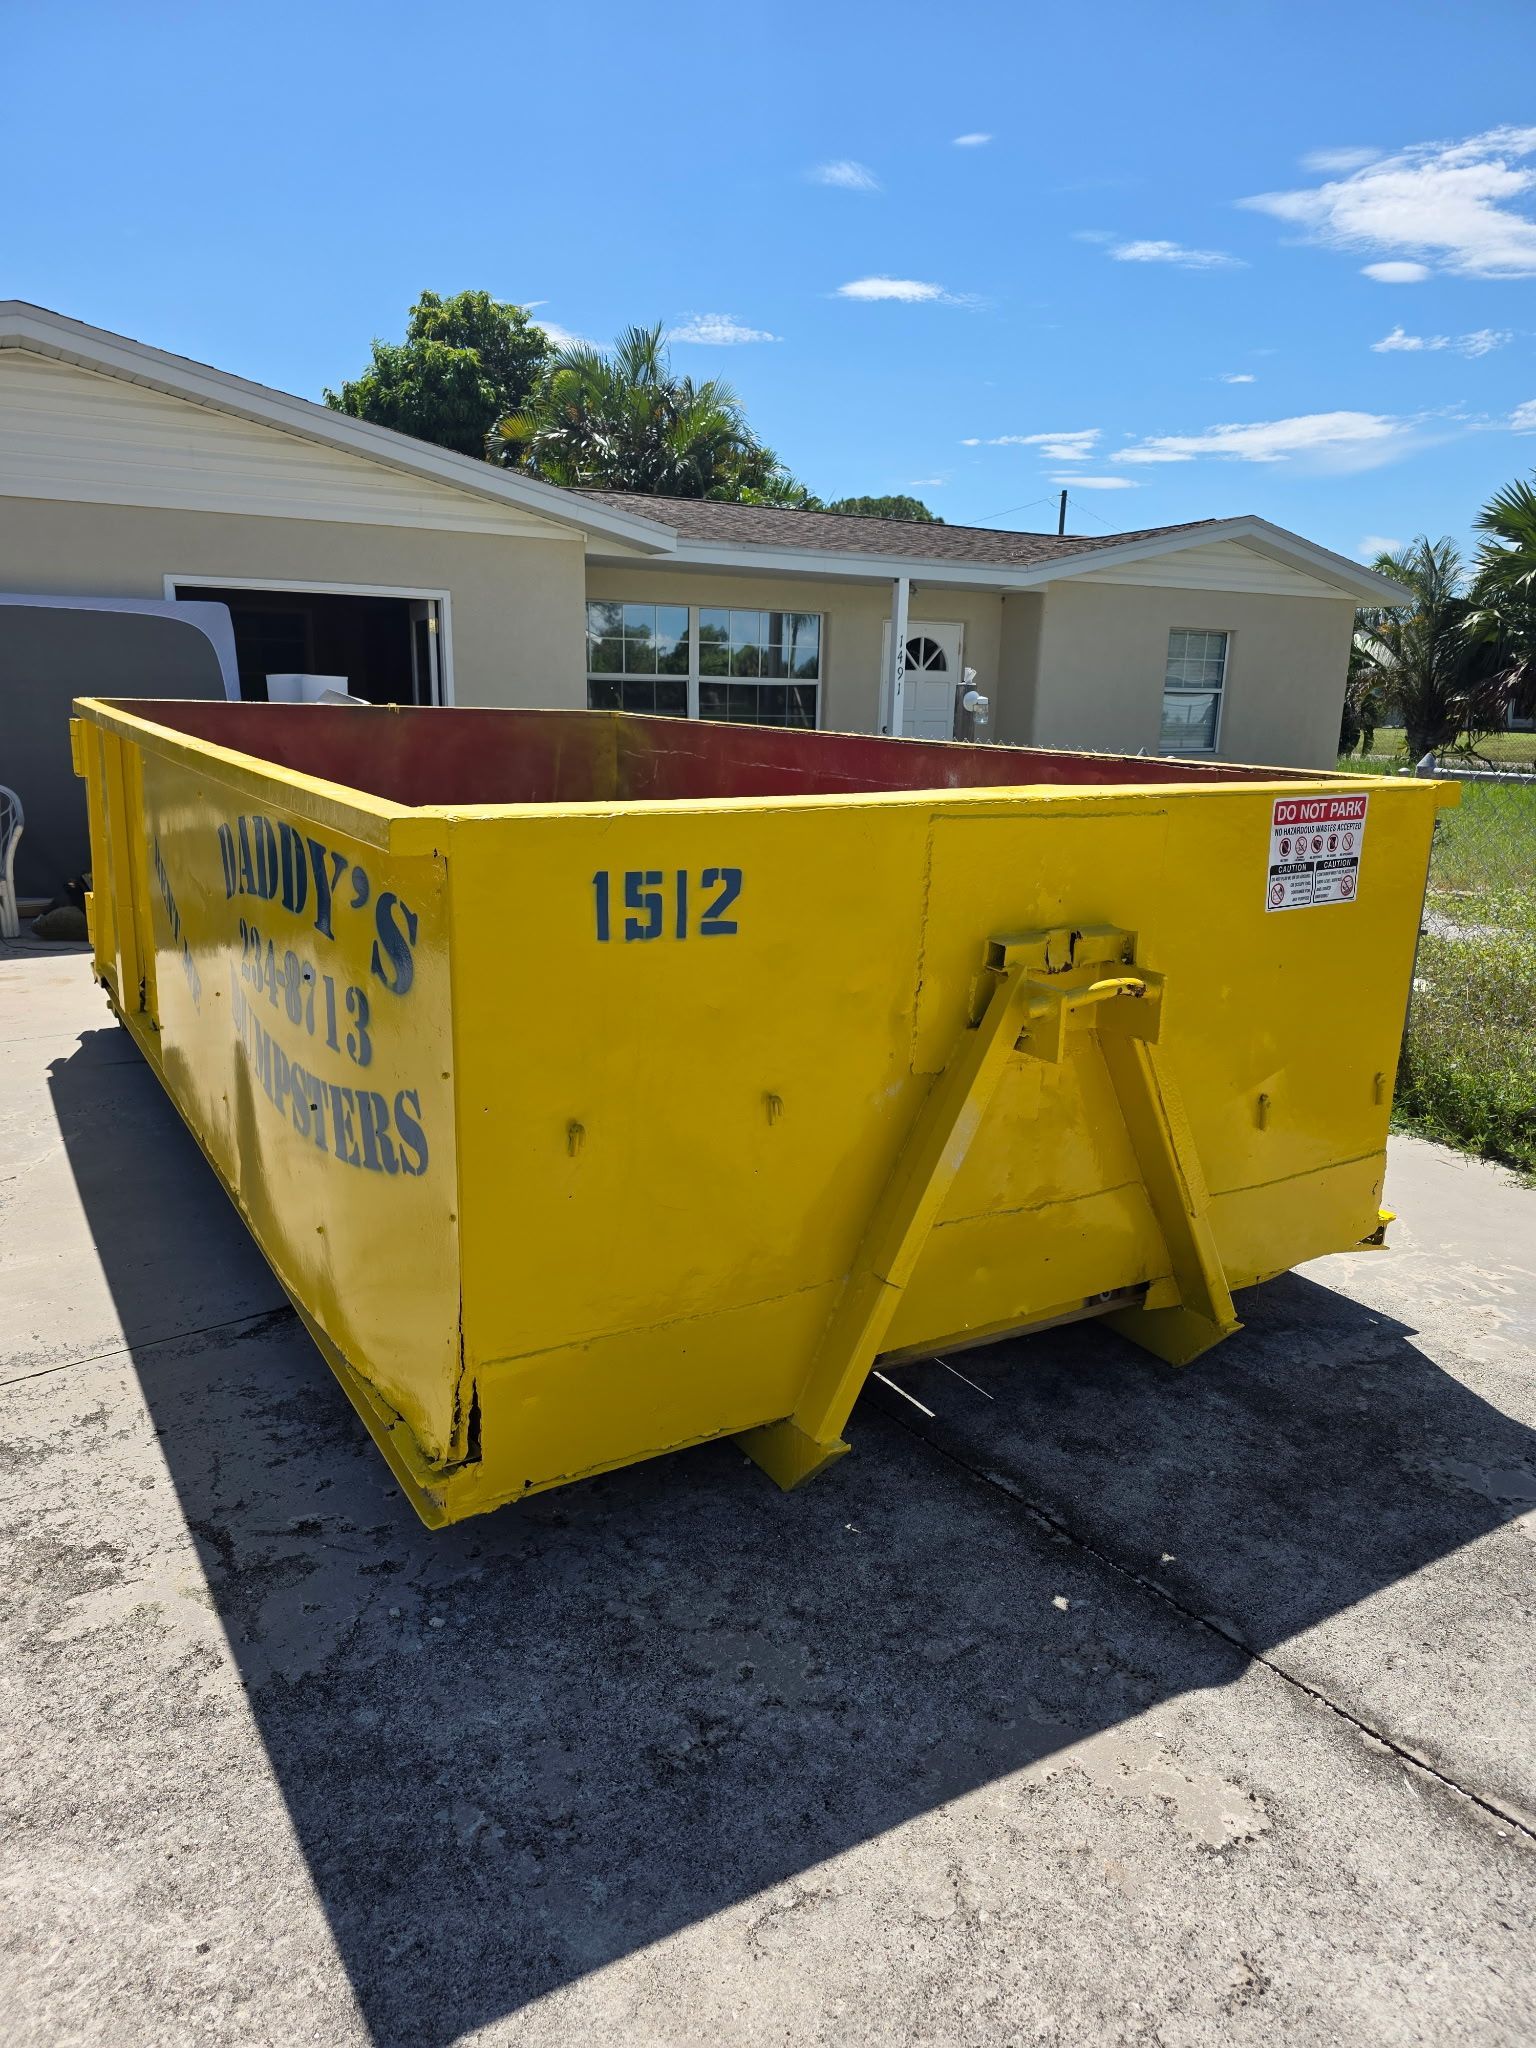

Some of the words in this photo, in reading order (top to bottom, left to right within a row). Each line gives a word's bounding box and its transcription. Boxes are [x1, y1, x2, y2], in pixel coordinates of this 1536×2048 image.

[1274, 828, 1283, 837] NO
[1283, 825, 1315, 836] HAZARDOUS
[1315, 823, 1337, 833] WASTES
[1337, 822, 1362, 831] ACCEPTED
[1277, 804, 1297, 822] DO
[1299, 802, 1328, 820] NOT
[1330, 800, 1363, 818] PARK
[1278, 864, 1307, 874] CAUTION
[1323, 859, 1352, 869] CAUTION
[217, 815, 418, 995] DADDY'S
[592, 867, 743, 942] 1512
[239, 917, 372, 1067] 234-8713
[230, 959, 429, 1177] DUMPSTERS
